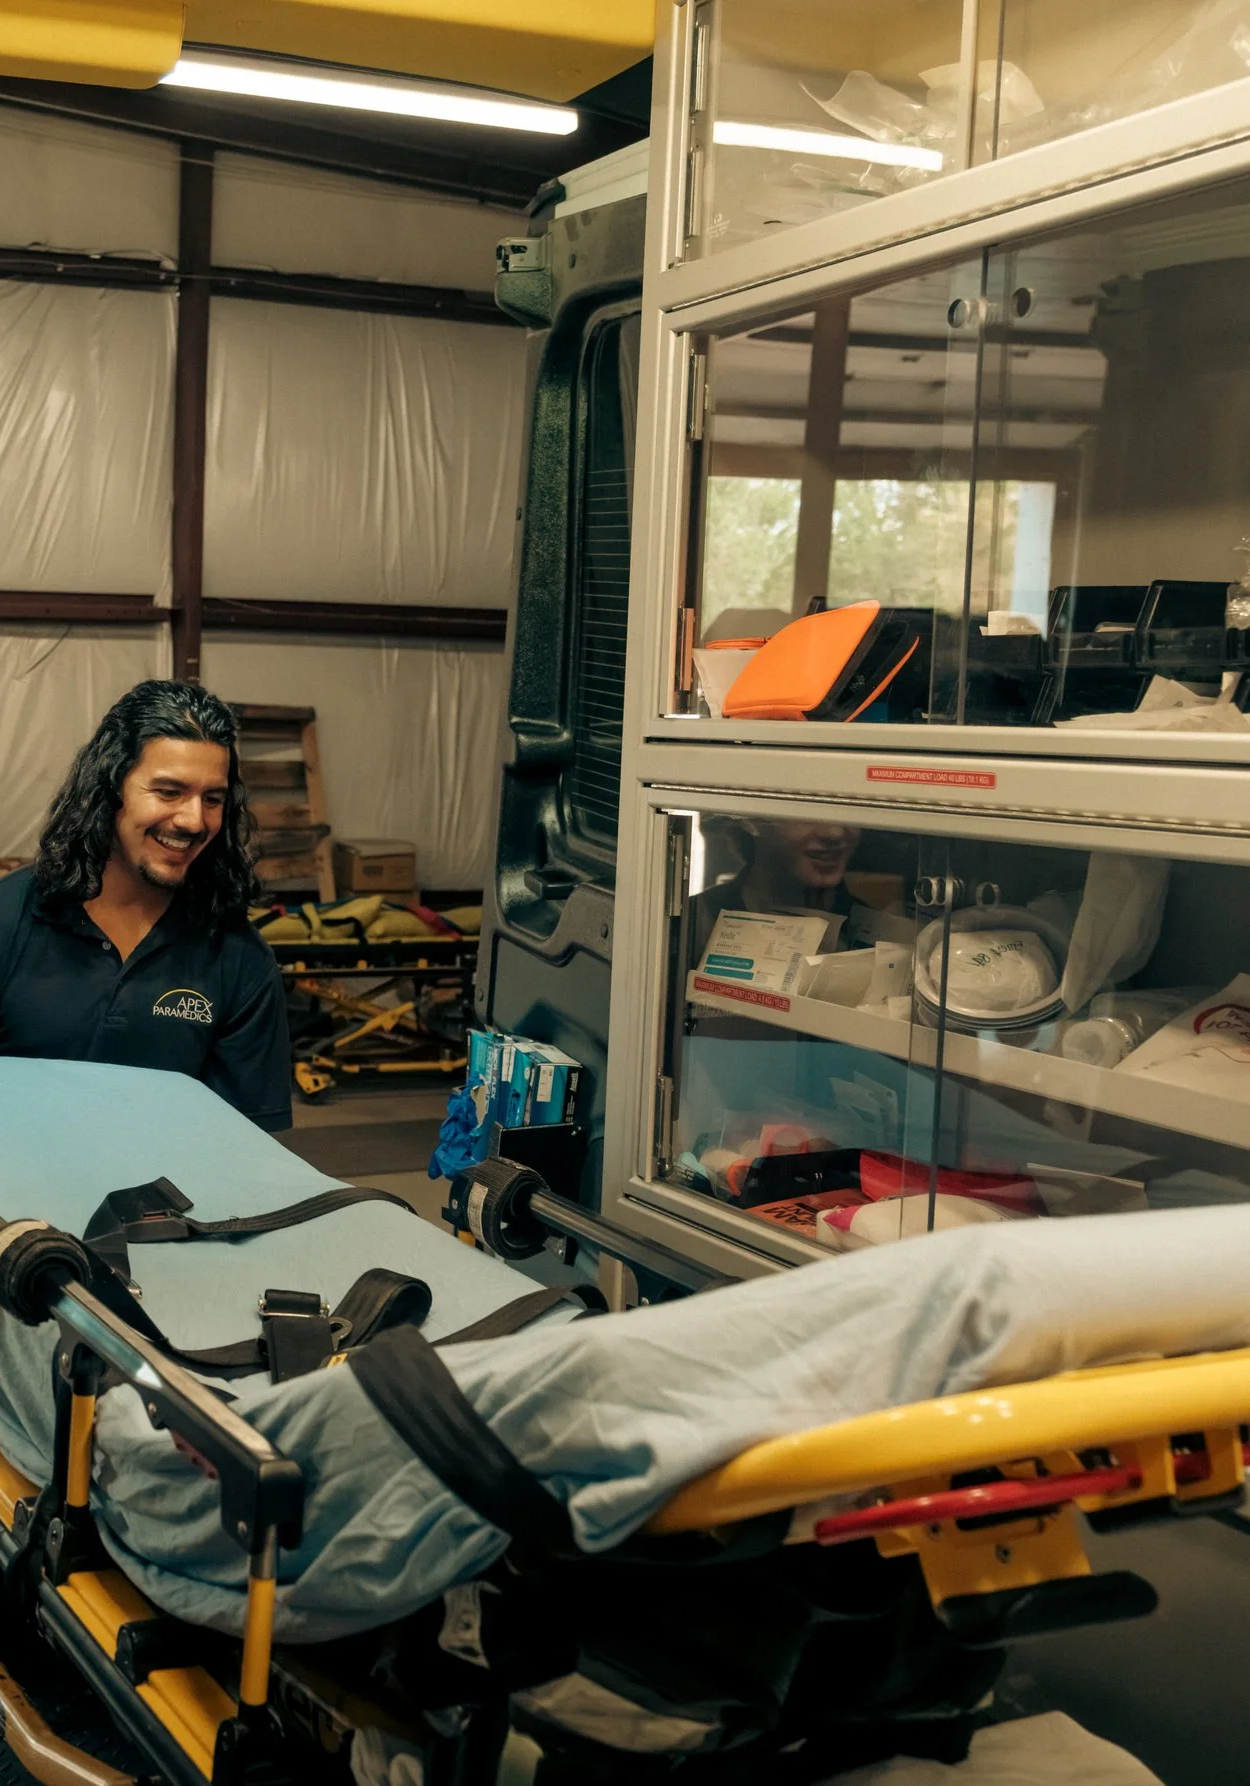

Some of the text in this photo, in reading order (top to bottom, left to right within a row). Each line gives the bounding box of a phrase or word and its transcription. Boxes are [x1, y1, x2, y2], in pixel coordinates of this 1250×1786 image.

[871, 769, 894, 779] MAXIMUM
[896, 771, 933, 781] COMPARTMENT
[934, 773, 948, 782] LOAD
[956, 774, 966, 783] LBS
[715, 985, 745, 998] COMPARTMENT
[177, 996, 213, 1014] APEX
[153, 1006, 213, 1023] PARAMEDICS
